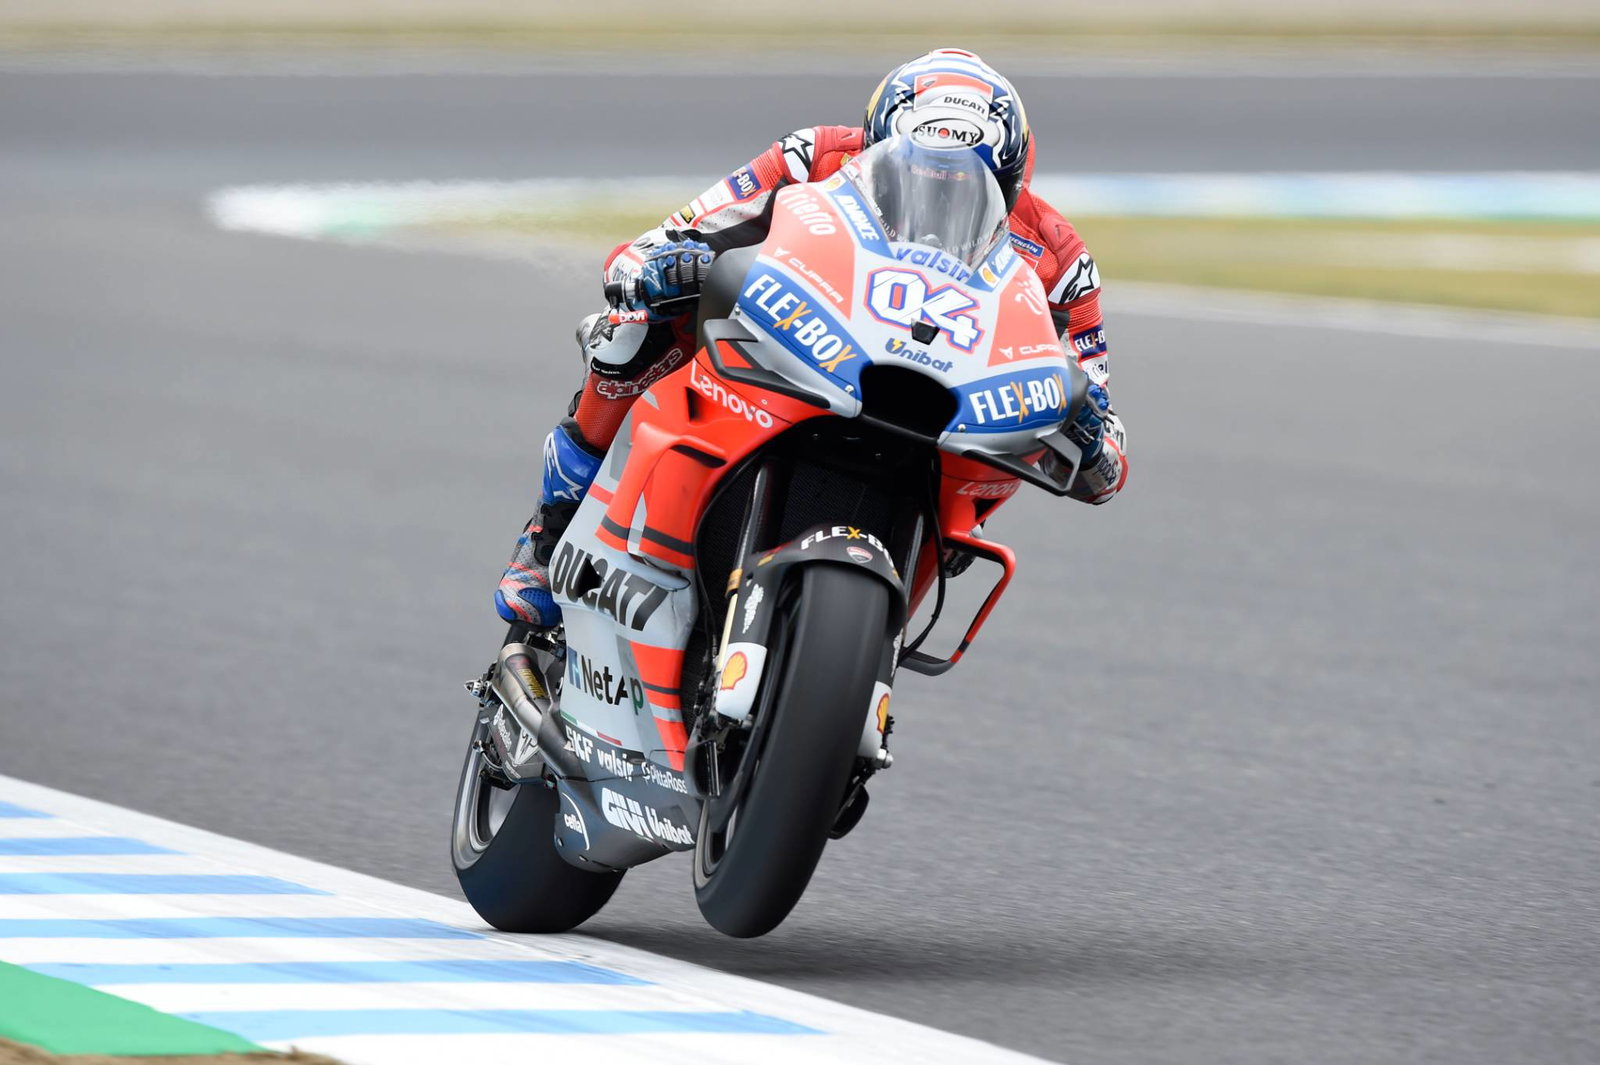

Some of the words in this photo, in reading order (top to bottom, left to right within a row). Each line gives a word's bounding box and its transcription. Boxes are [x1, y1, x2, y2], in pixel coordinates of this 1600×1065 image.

[944, 96, 985, 114] DUCATI
[918, 125, 979, 144] SUOMY
[789, 257, 844, 303] CUPRA
[895, 247, 971, 282] valsir
[744, 274, 857, 373] FLEX-BOX
[865, 267, 984, 354] 04
[597, 348, 682, 399] alpinestars
[885, 337, 954, 373] Unibat
[690, 357, 774, 428] Lenovo
[969, 373, 1067, 424] FLEX-BOX
[564, 725, 594, 763] SKF
[597, 748, 634, 782] valsir
[602, 787, 654, 839] GIVI
[645, 805, 695, 845] Unibat
